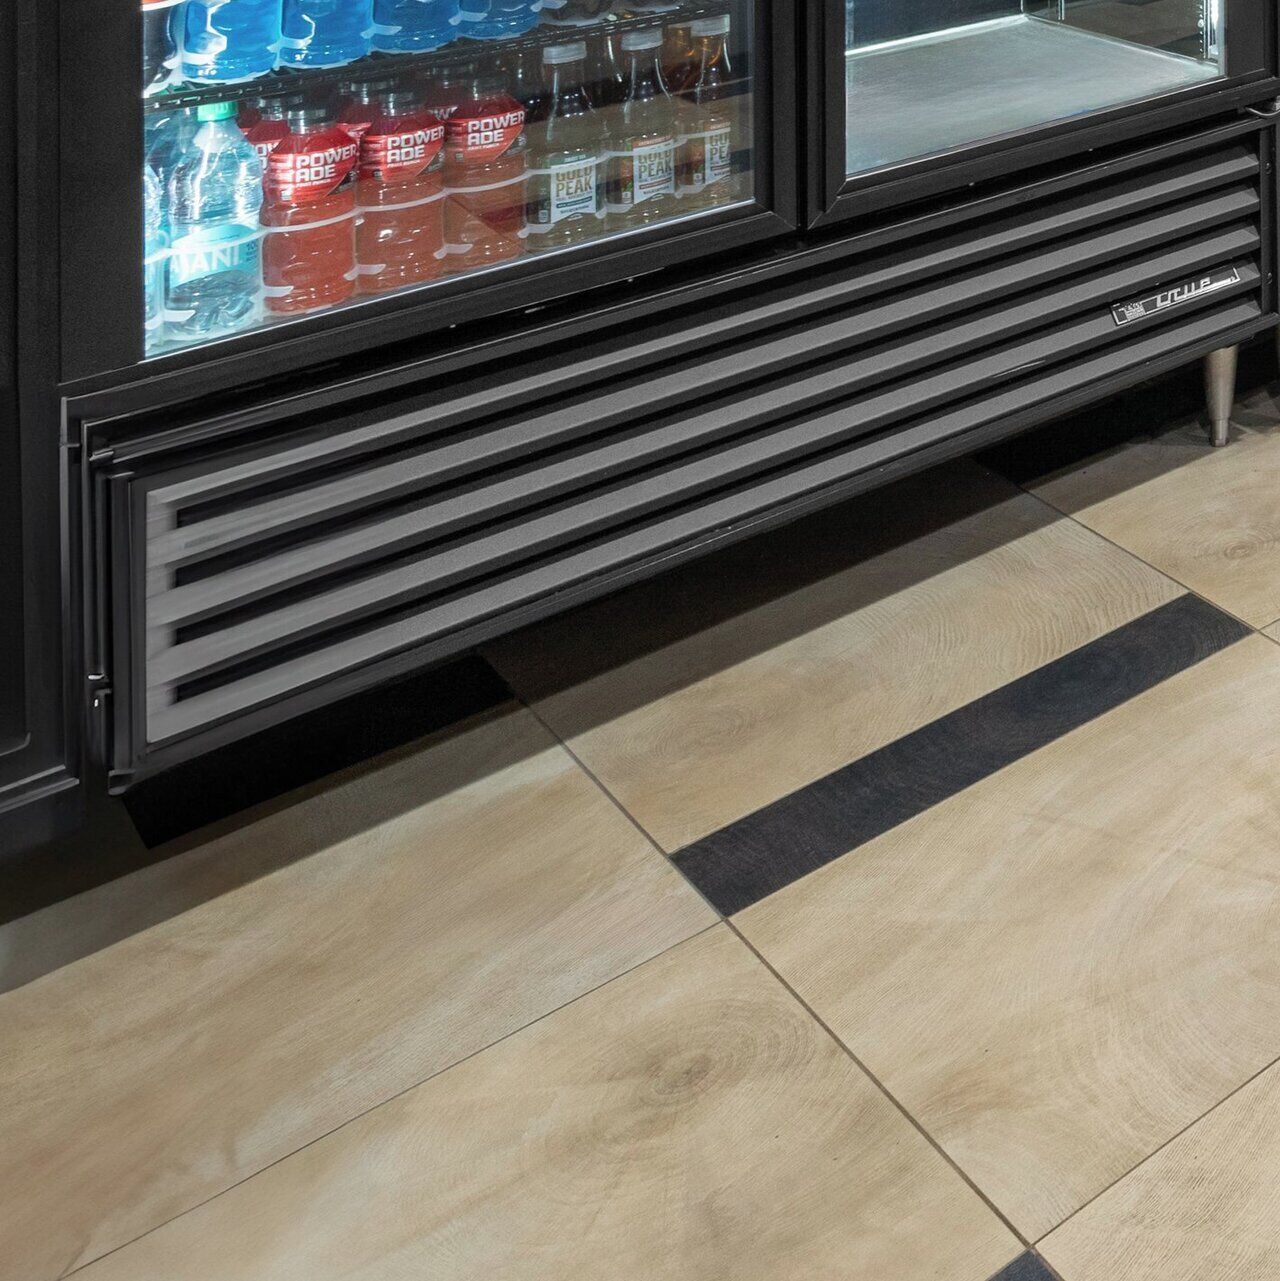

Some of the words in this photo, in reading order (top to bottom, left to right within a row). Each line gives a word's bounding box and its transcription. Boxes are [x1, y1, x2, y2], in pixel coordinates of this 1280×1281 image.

[468, 111, 525, 133] POWER
[387, 126, 444, 149] POWER
[467, 130, 504, 146] ADE
[387, 147, 425, 162] ADE
[296, 166, 336, 181] ADE
[639, 163, 672, 179] PEAK
[556, 181, 592, 197] PEAK
